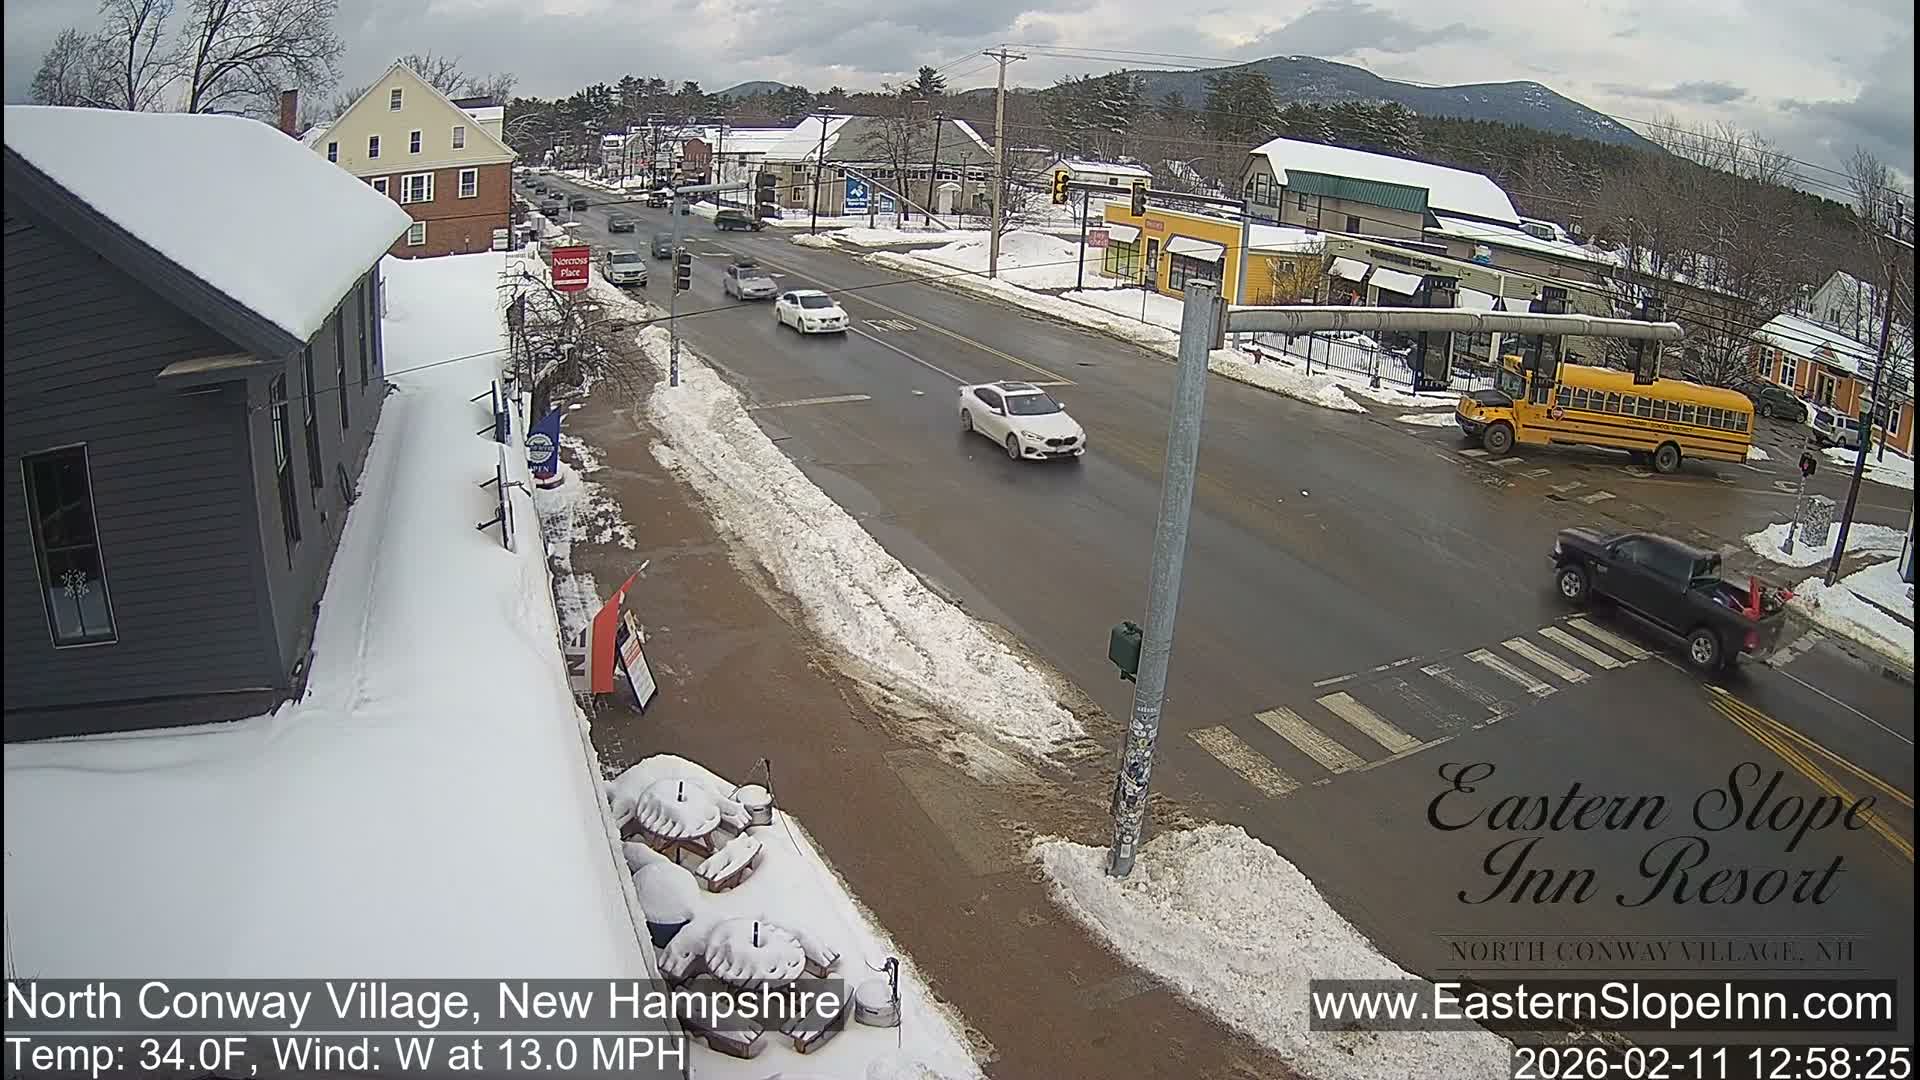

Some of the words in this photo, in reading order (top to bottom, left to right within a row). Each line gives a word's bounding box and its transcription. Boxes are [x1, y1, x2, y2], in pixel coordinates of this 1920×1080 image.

[554, 257, 588, 266] Norcross
[560, 268, 581, 277] Place
[530, 465, 550, 473] PEN
